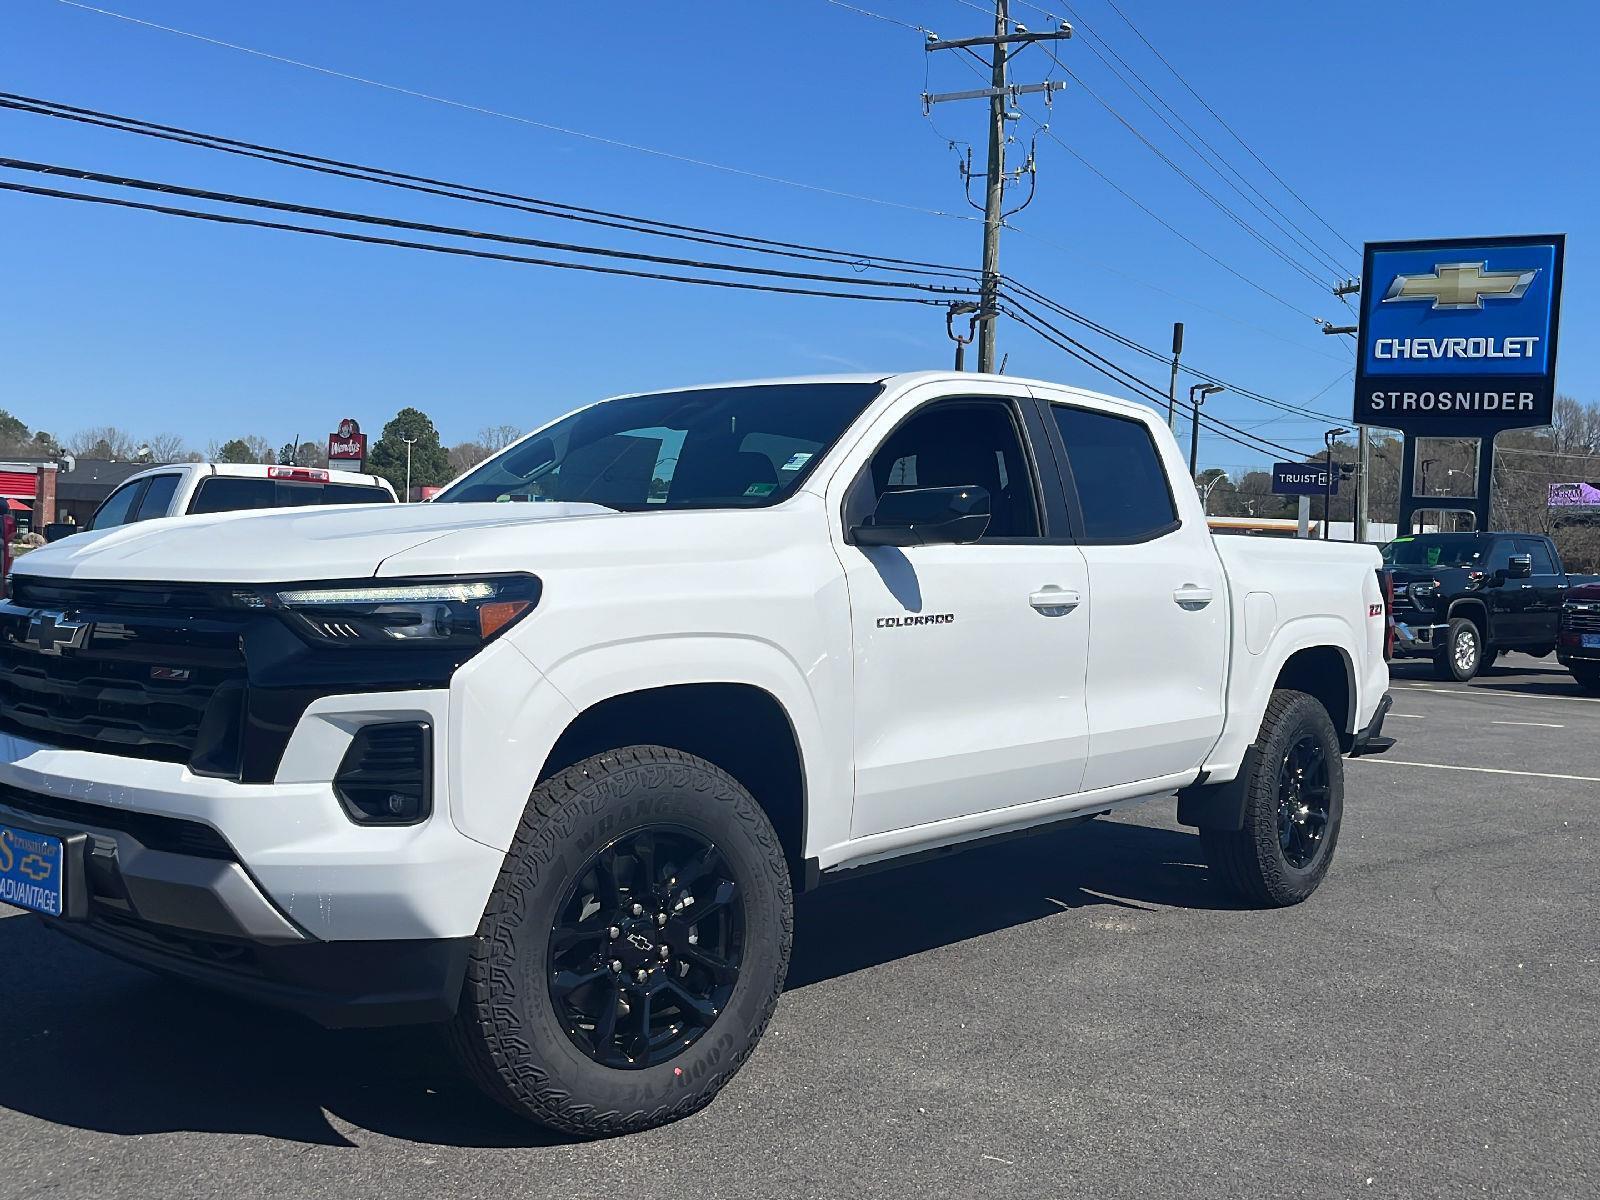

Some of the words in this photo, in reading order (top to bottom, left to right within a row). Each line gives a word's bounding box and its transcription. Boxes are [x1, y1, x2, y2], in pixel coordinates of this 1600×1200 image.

[1374, 336, 1540, 359] CHEVROLET
[1371, 391, 1535, 411] STROSNIDER
[331, 439, 361, 456] Wendy's
[1279, 474, 1318, 483] TRUIST
[876, 613, 955, 629] COLORADO
[0, 877, 58, 913] ADVANTAGE
